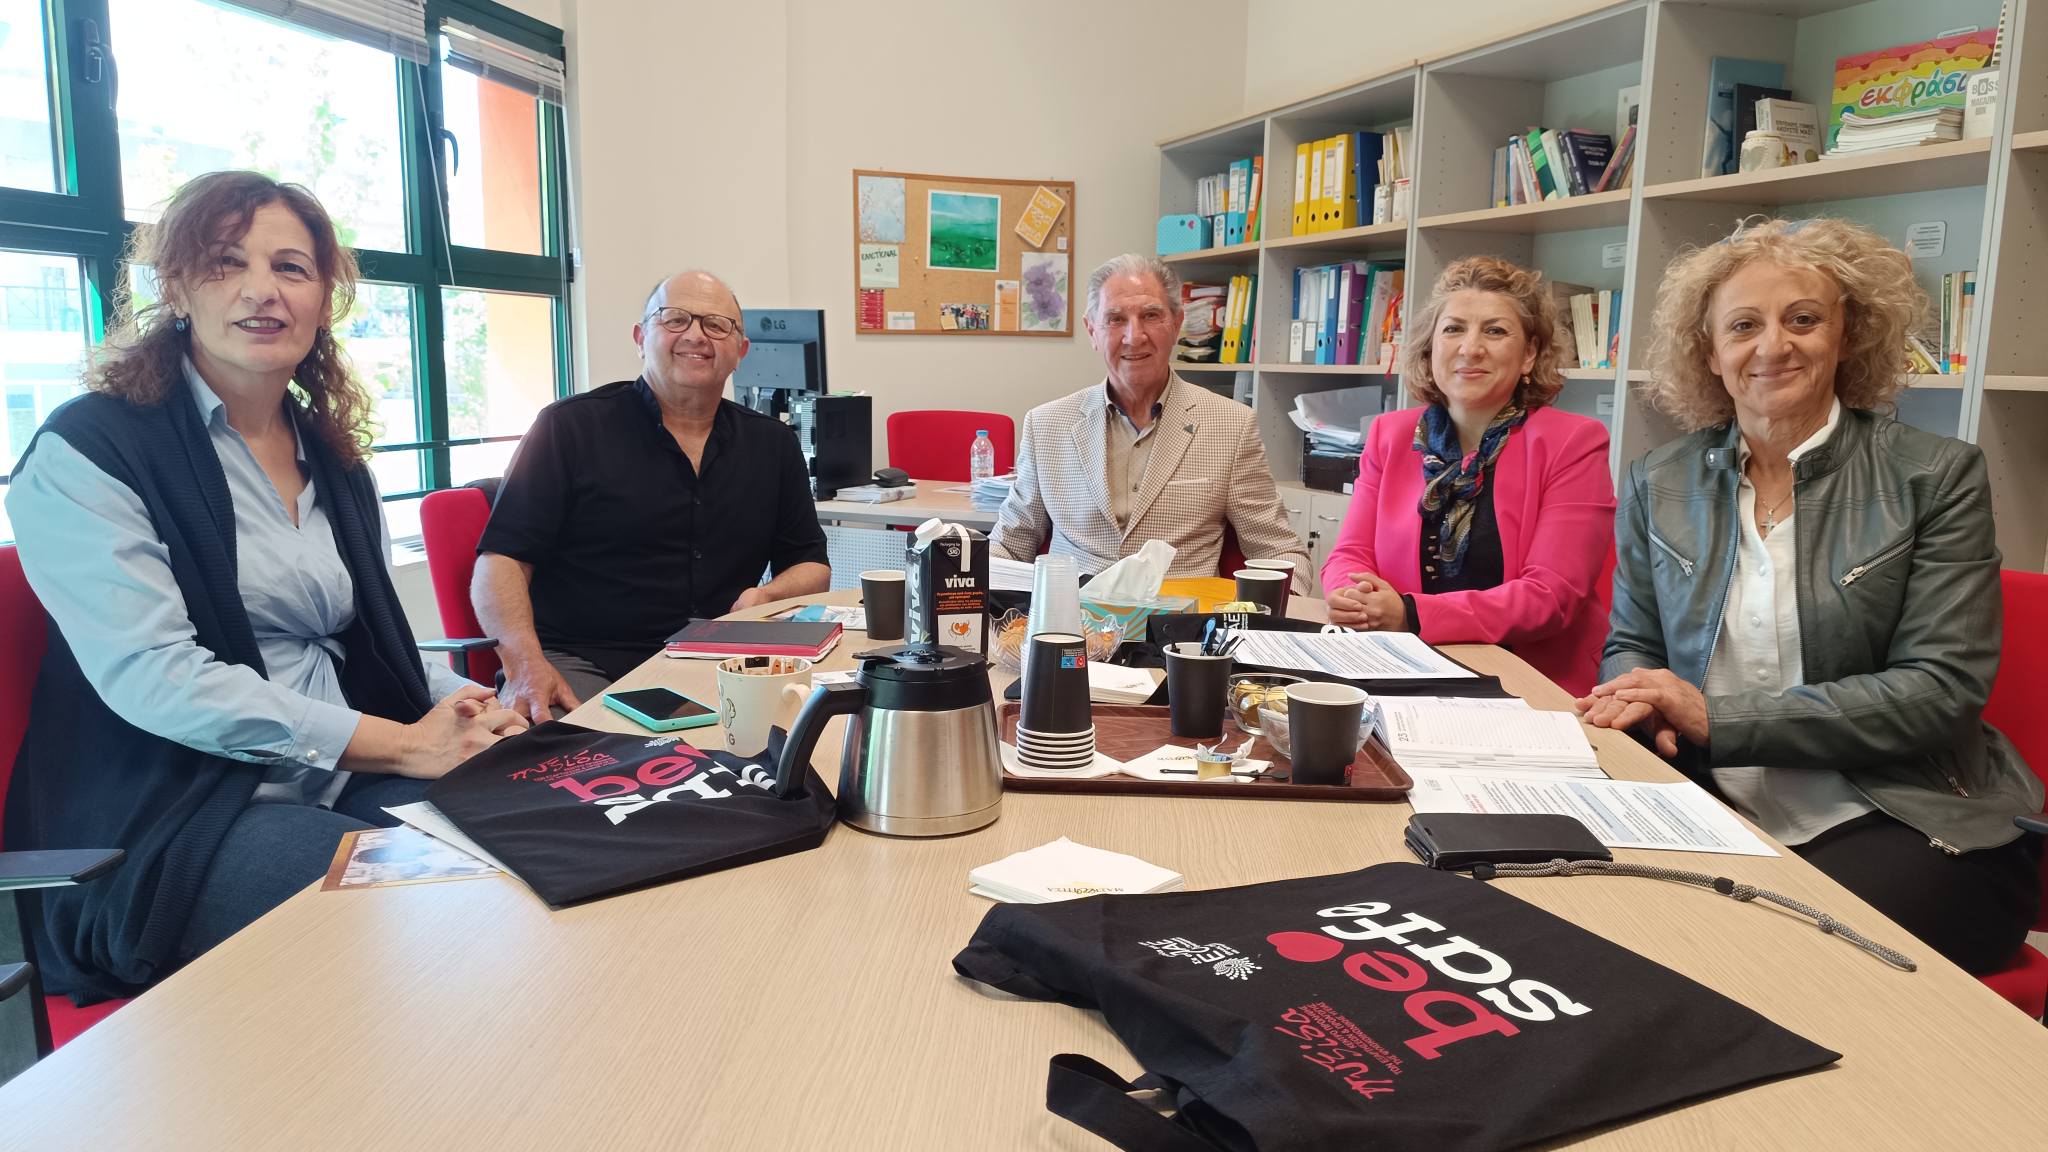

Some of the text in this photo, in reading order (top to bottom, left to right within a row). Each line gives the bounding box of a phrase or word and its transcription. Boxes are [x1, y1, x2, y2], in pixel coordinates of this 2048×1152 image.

[773, 320, 786, 330] LG
[944, 574, 975, 588] viva
[549, 756, 697, 803] be
[1316, 901, 1593, 1022] safe
[1343, 950, 1521, 1060] be
